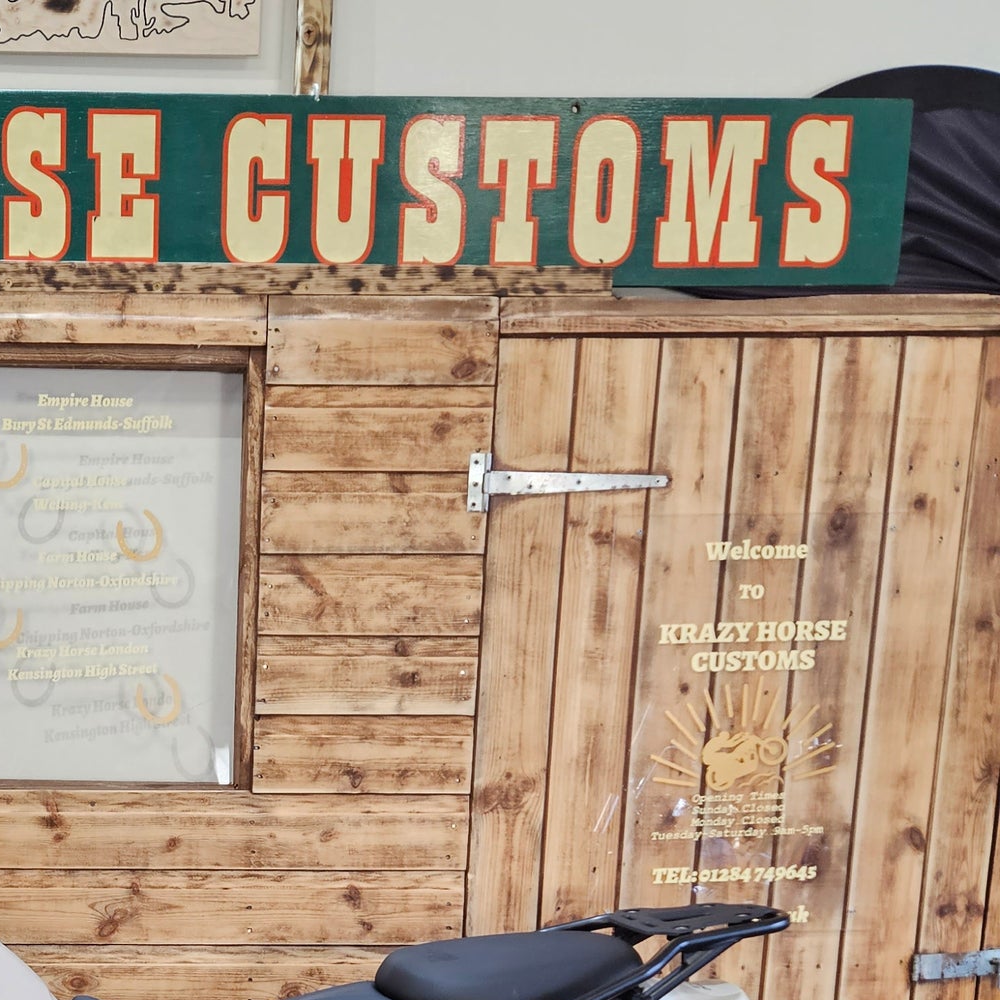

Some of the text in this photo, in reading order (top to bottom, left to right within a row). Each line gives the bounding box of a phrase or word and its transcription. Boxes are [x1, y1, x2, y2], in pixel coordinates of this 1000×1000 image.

[221, 112, 854, 269] CUSTOMS
[37, 393, 134, 411] Empire House
[2, 415, 174, 435] Bury St Edmunds-Suffolk
[38, 550, 118, 564] Farm House
[705, 539, 809, 561] Welcome
[48, 573, 179, 590] Norton-Oxfordshire
[739, 584, 765, 600] TO
[658, 620, 847, 645] KRAZY HORSE
[16, 642, 149, 661] Krazy Horse London
[691, 649, 816, 672] CUSTOMS
[7, 662, 159, 682] Kensington High Street
[692, 791, 785, 805] Opening Times
[692, 803, 785, 816] Sunday Closed
[691, 815, 785, 828] Monday Closed
[652, 864, 818, 885] TEL: 01284 749645
